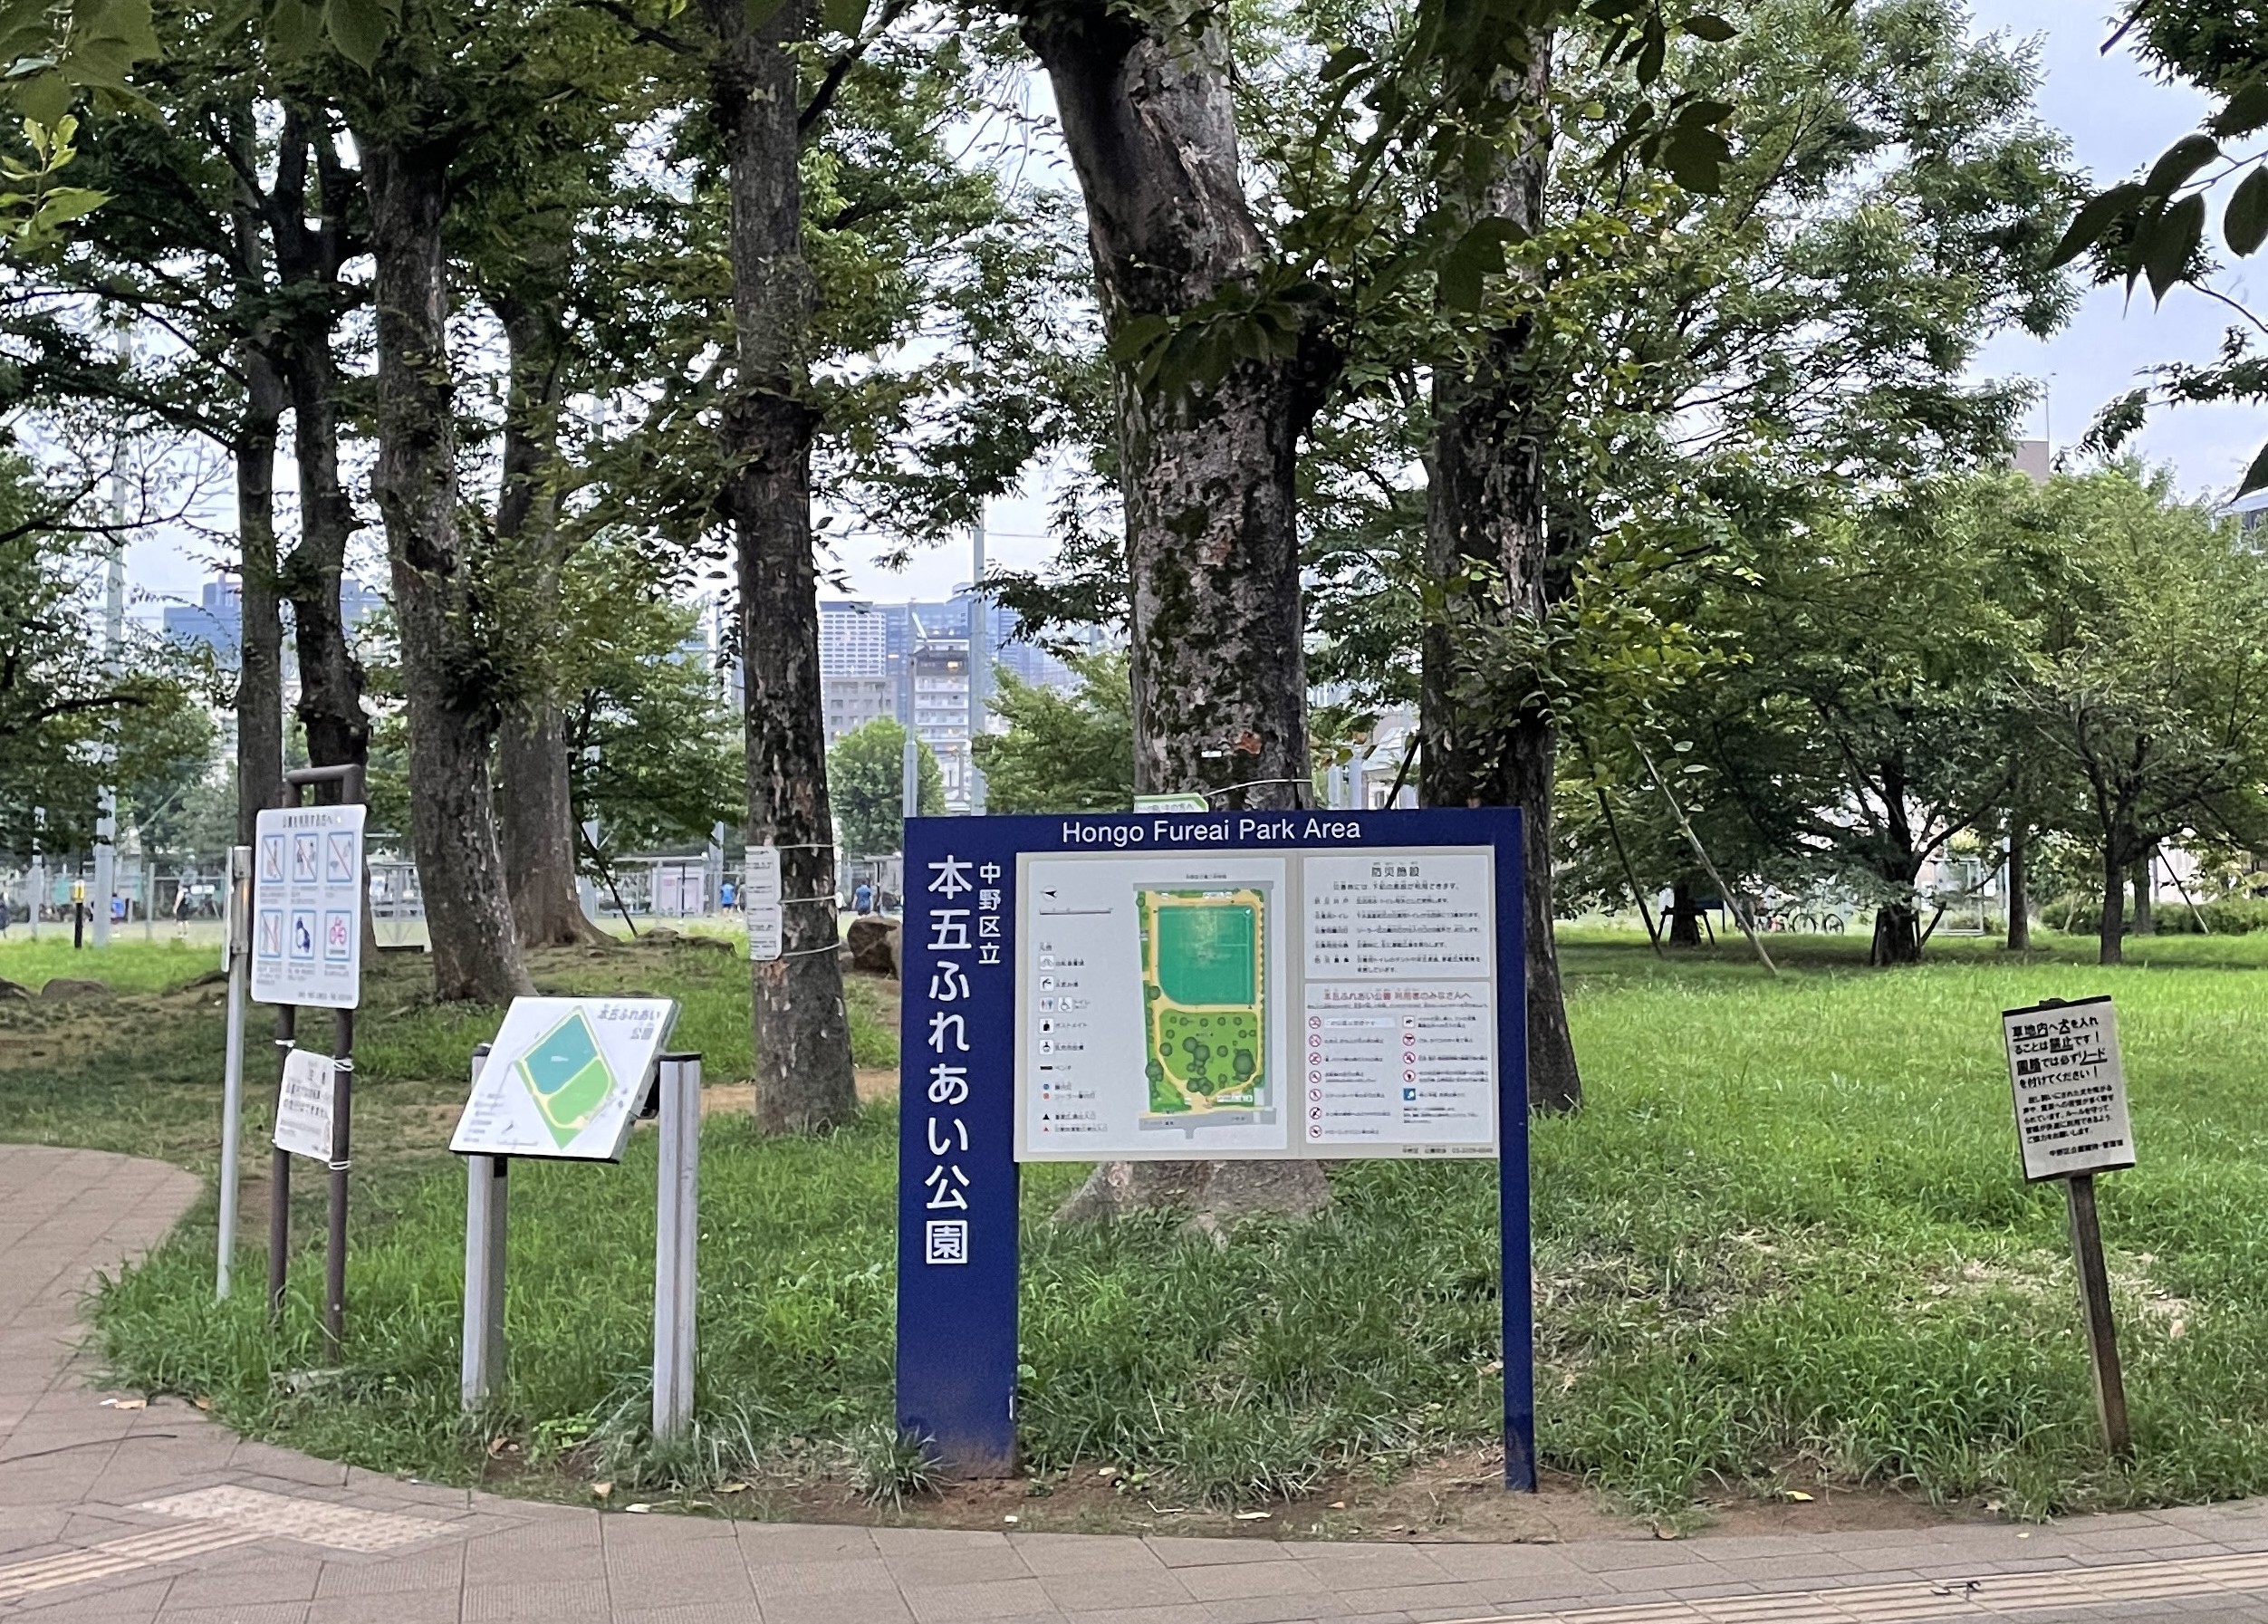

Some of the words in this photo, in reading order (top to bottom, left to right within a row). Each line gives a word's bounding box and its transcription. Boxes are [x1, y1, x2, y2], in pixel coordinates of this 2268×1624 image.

[1062, 822, 1144, 847] Hongo
[1154, 819, 1229, 841] Fureai
[1238, 818, 1295, 841] Park
[1302, 817, 1361, 840] Area
[978, 861, 1001, 965] 中野区立
[925, 854, 973, 1265] 本五ふれあい公園
